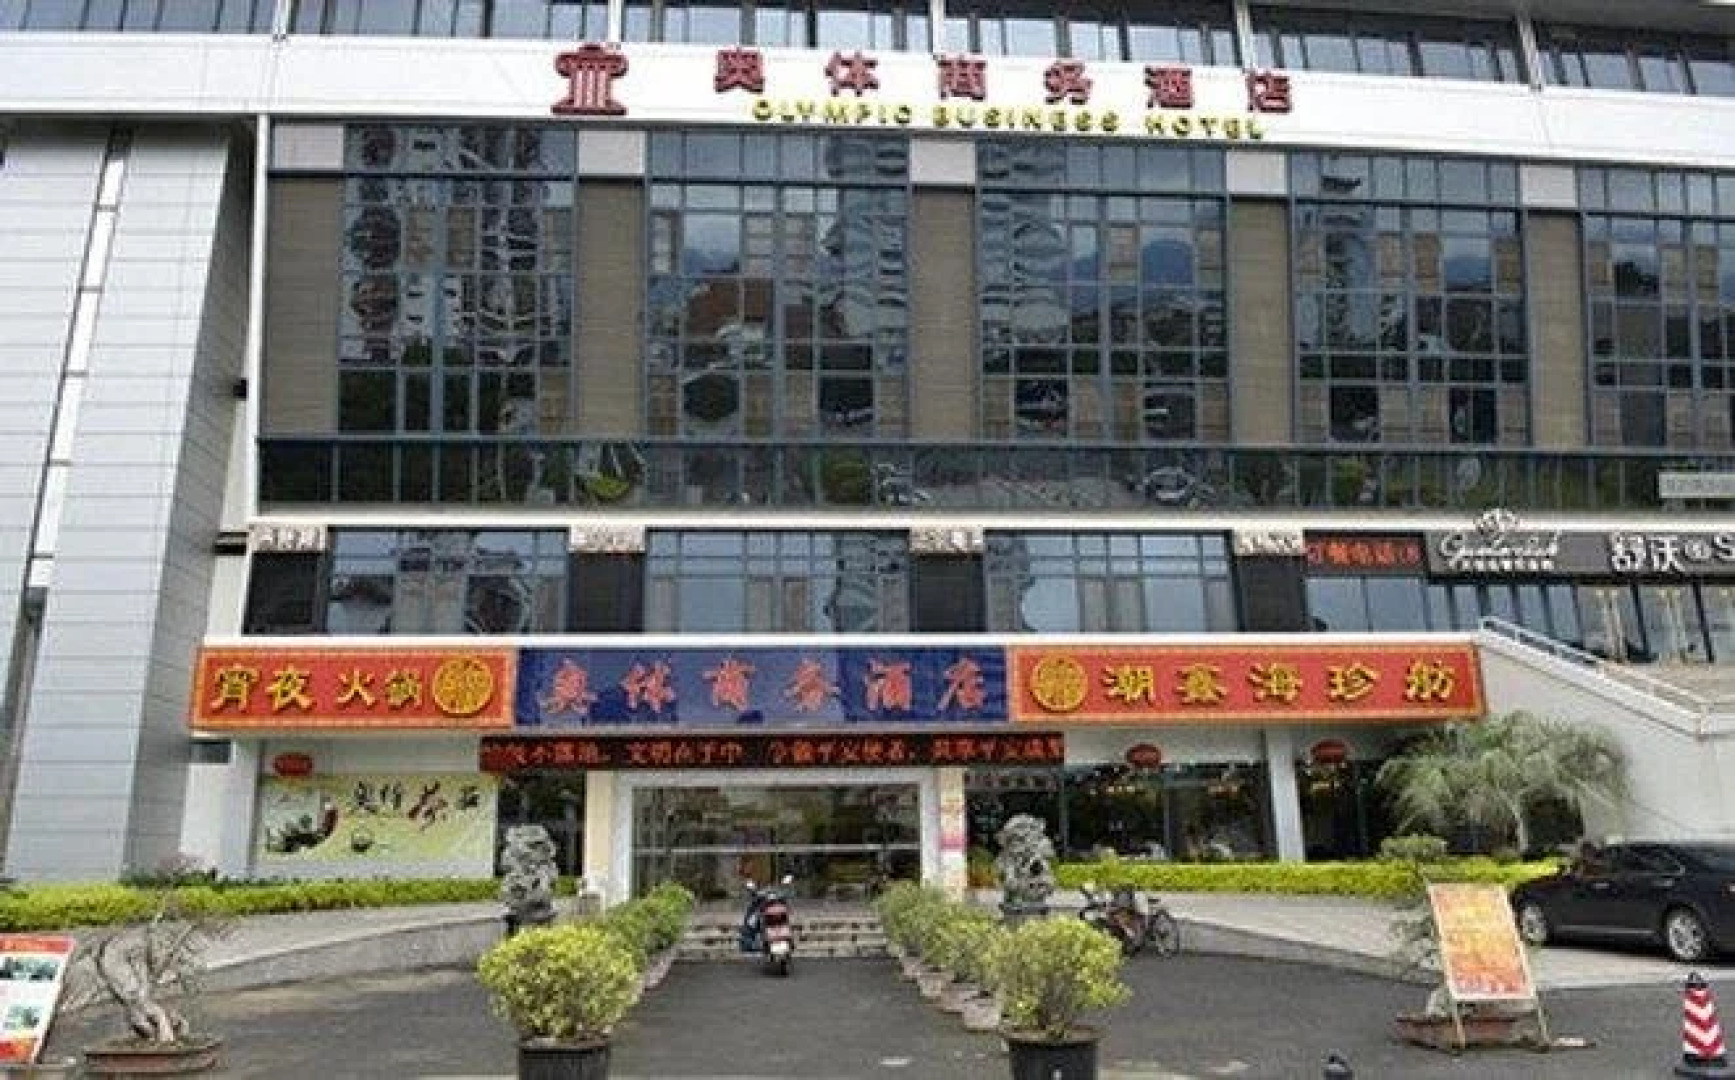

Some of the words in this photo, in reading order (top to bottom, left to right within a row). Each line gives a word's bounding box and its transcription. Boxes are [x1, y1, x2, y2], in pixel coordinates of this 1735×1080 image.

[714, 47, 1292, 113] 奥体商务酒店
[751, 99, 912, 124] OLYMPIC
[932, 106, 1119, 132] BUSINESS
[1143, 115, 1265, 140] HOTEL
[537, 657, 988, 715] 奥体商务酒店
